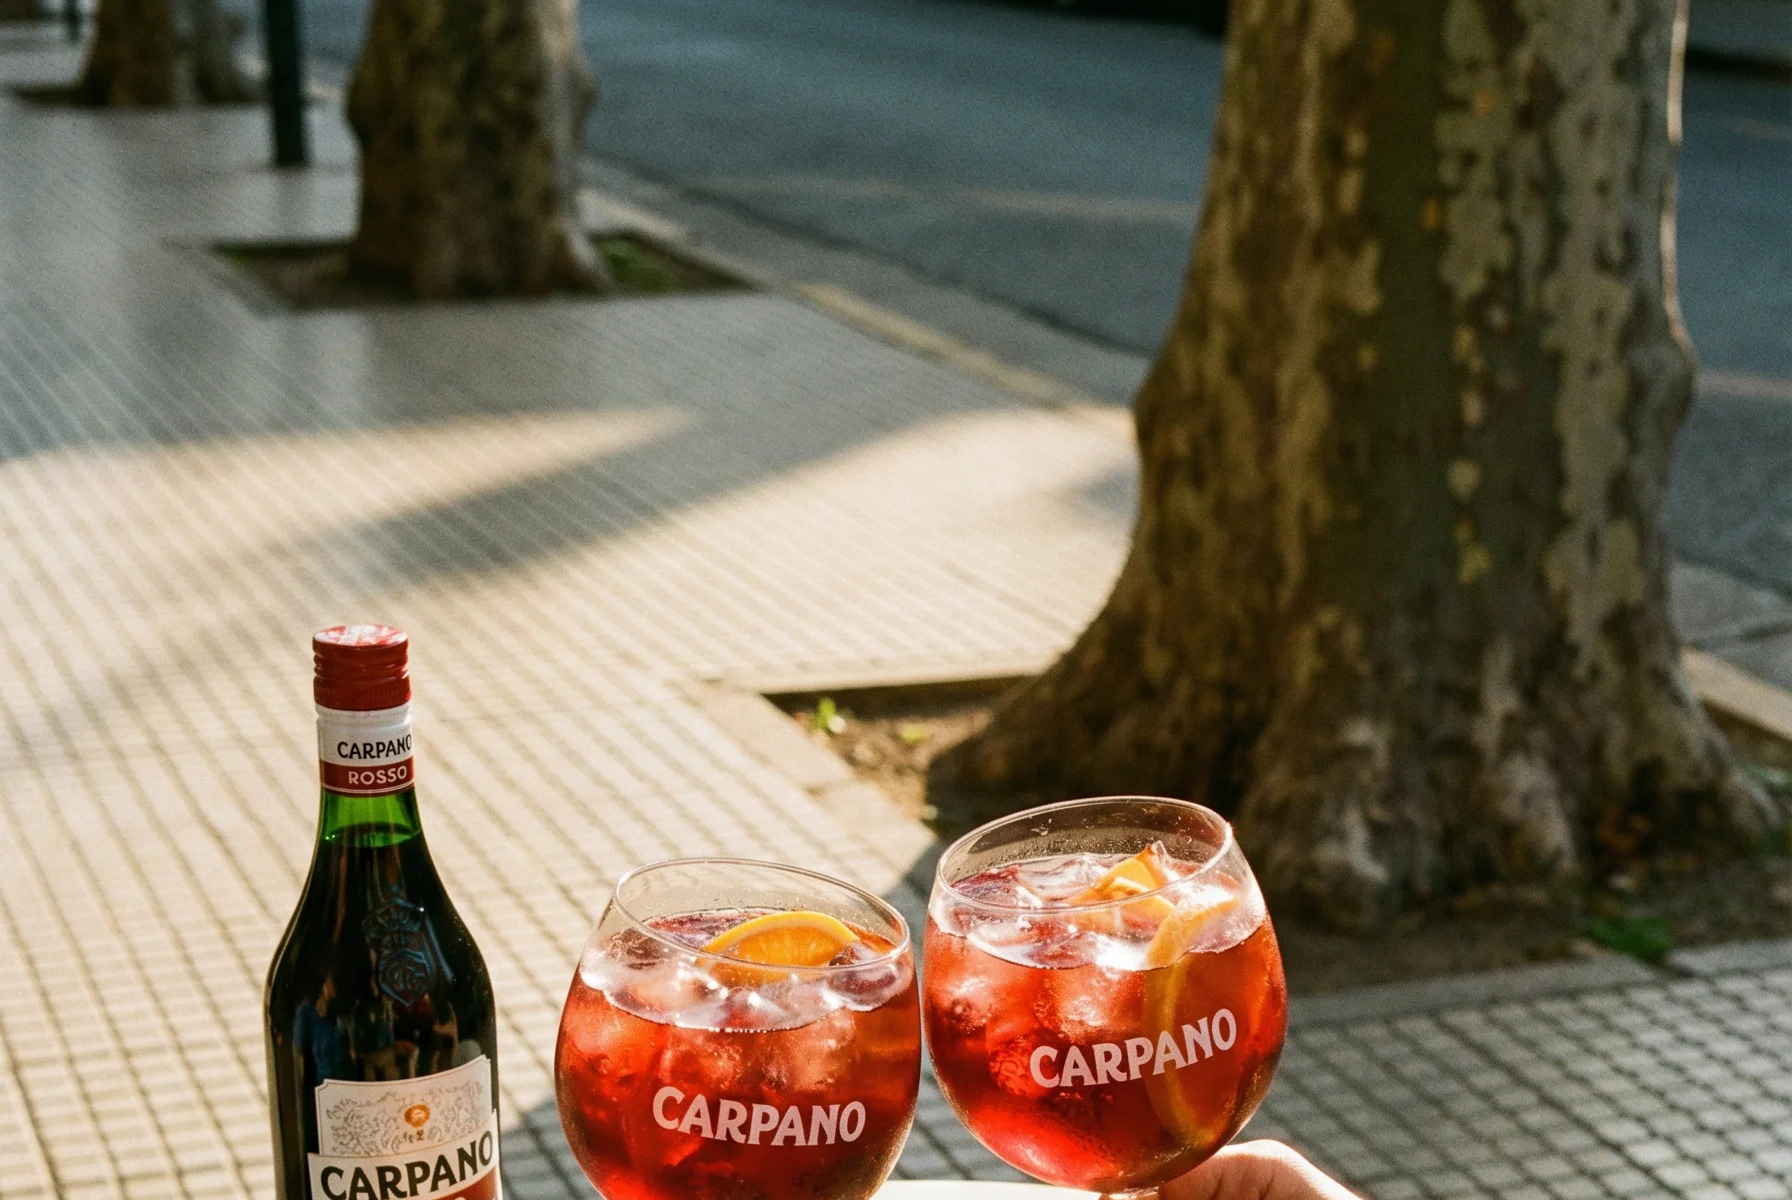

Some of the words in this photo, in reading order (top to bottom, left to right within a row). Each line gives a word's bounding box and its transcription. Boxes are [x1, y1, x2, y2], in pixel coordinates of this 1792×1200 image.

[337, 734, 412, 759] CARPANO
[348, 765, 407, 785] ROSSO
[1029, 1008, 1237, 1089] CARPANO
[652, 1086, 866, 1147] CARPANO
